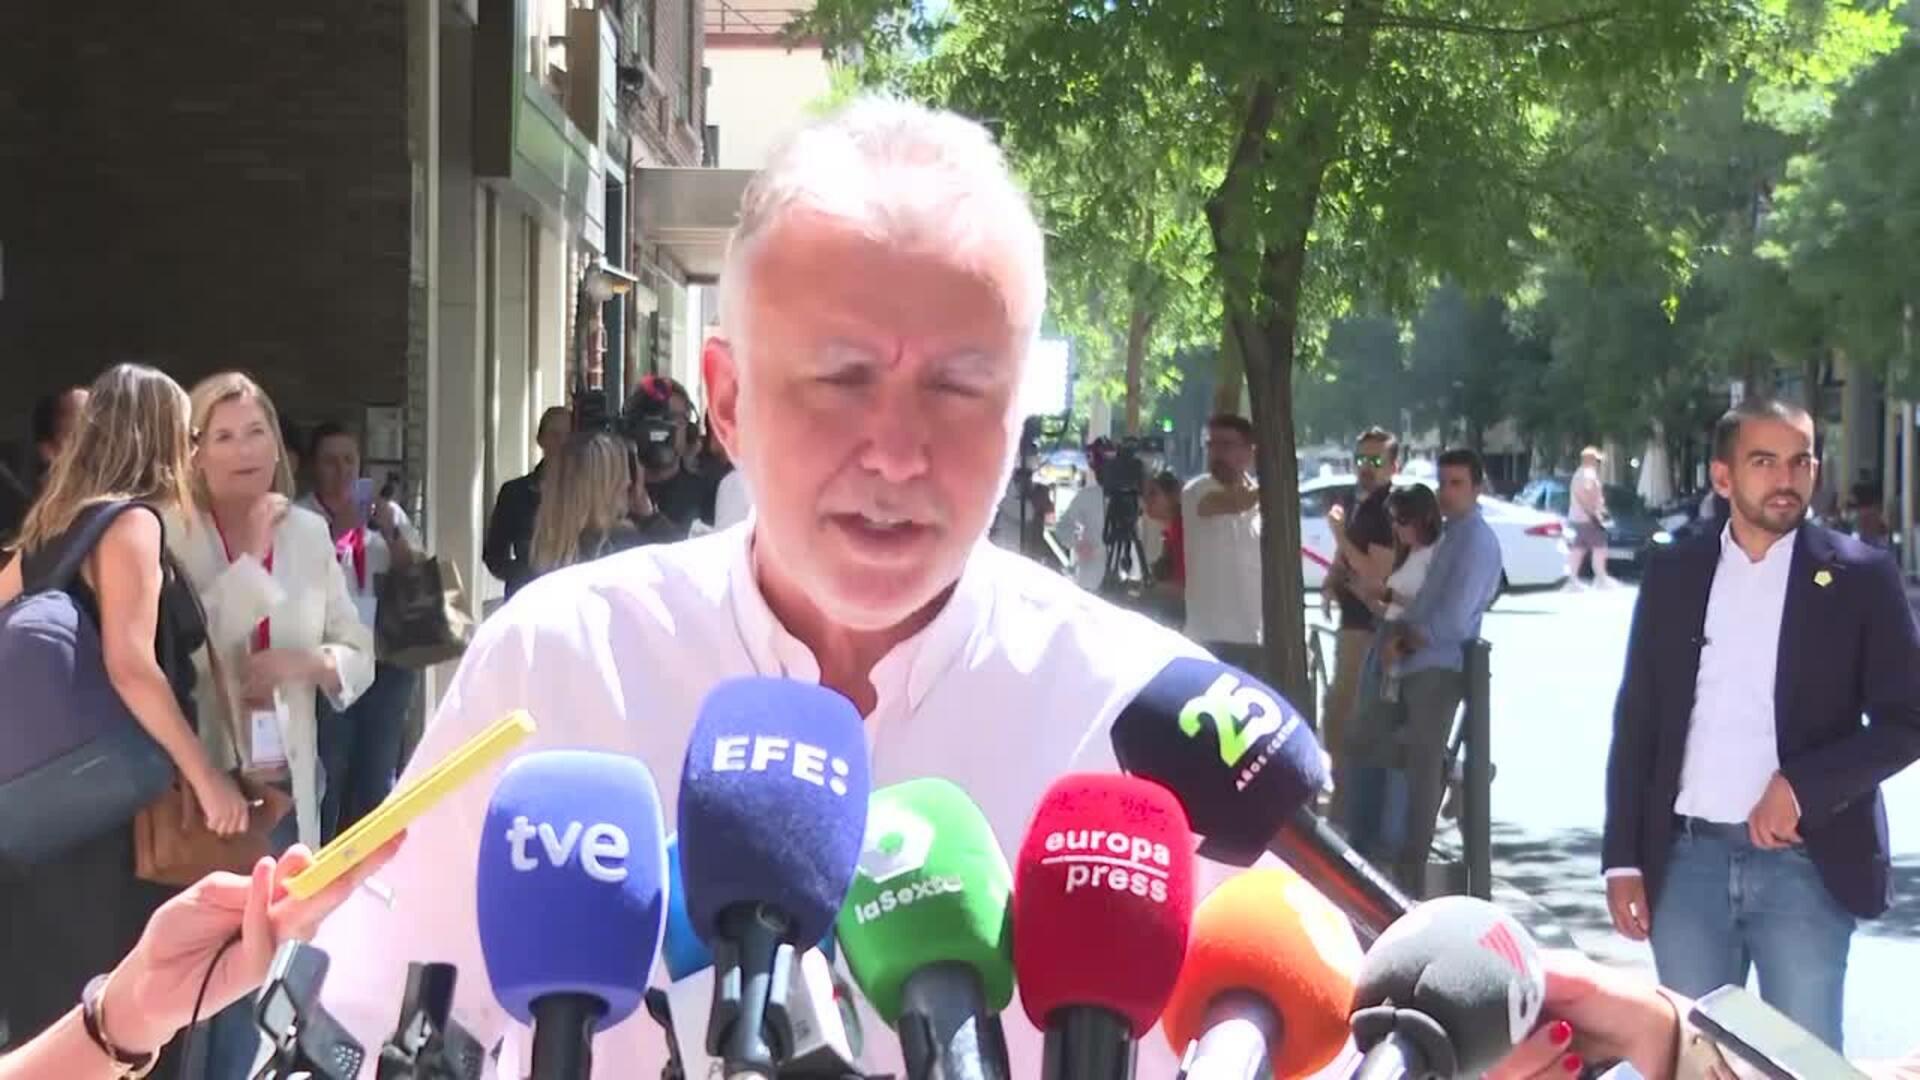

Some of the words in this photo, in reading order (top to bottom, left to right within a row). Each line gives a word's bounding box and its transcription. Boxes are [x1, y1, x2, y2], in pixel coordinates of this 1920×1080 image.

[1178, 672, 1282, 767] 25
[712, 735, 849, 796] EFE:
[505, 815, 630, 882] tve
[1045, 829, 1170, 866] europa
[1066, 864, 1168, 903] press
